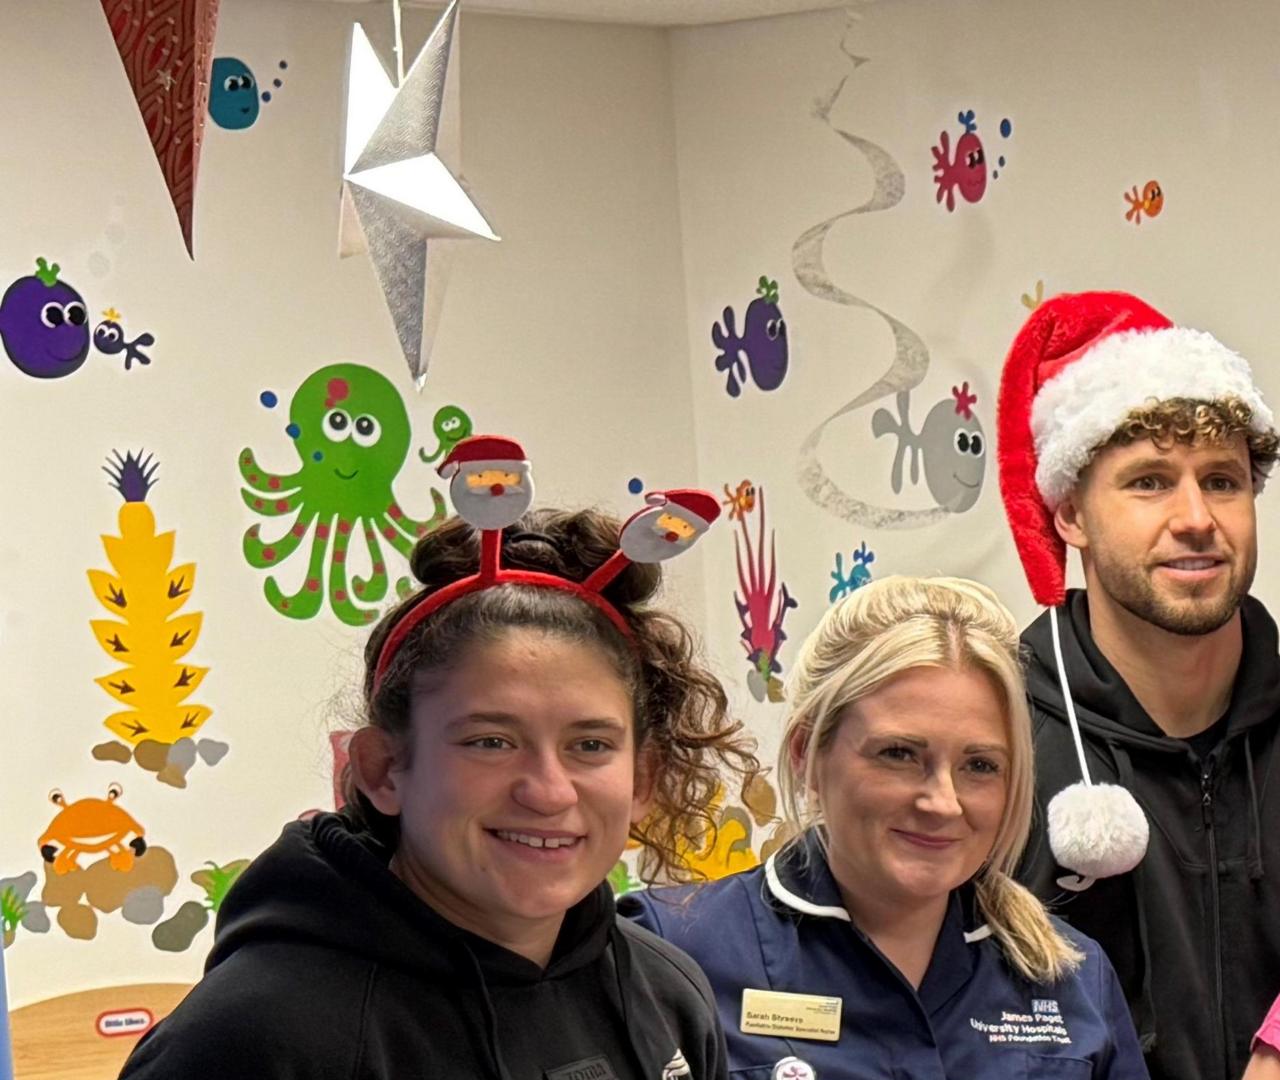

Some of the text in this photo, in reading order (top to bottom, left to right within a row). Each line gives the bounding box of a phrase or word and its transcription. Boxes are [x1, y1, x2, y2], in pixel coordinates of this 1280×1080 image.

[1033, 1000, 1059, 1013] NHS
[1001, 1012, 1064, 1025] James Paget
[970, 1018, 1068, 1036] University Hospitals
